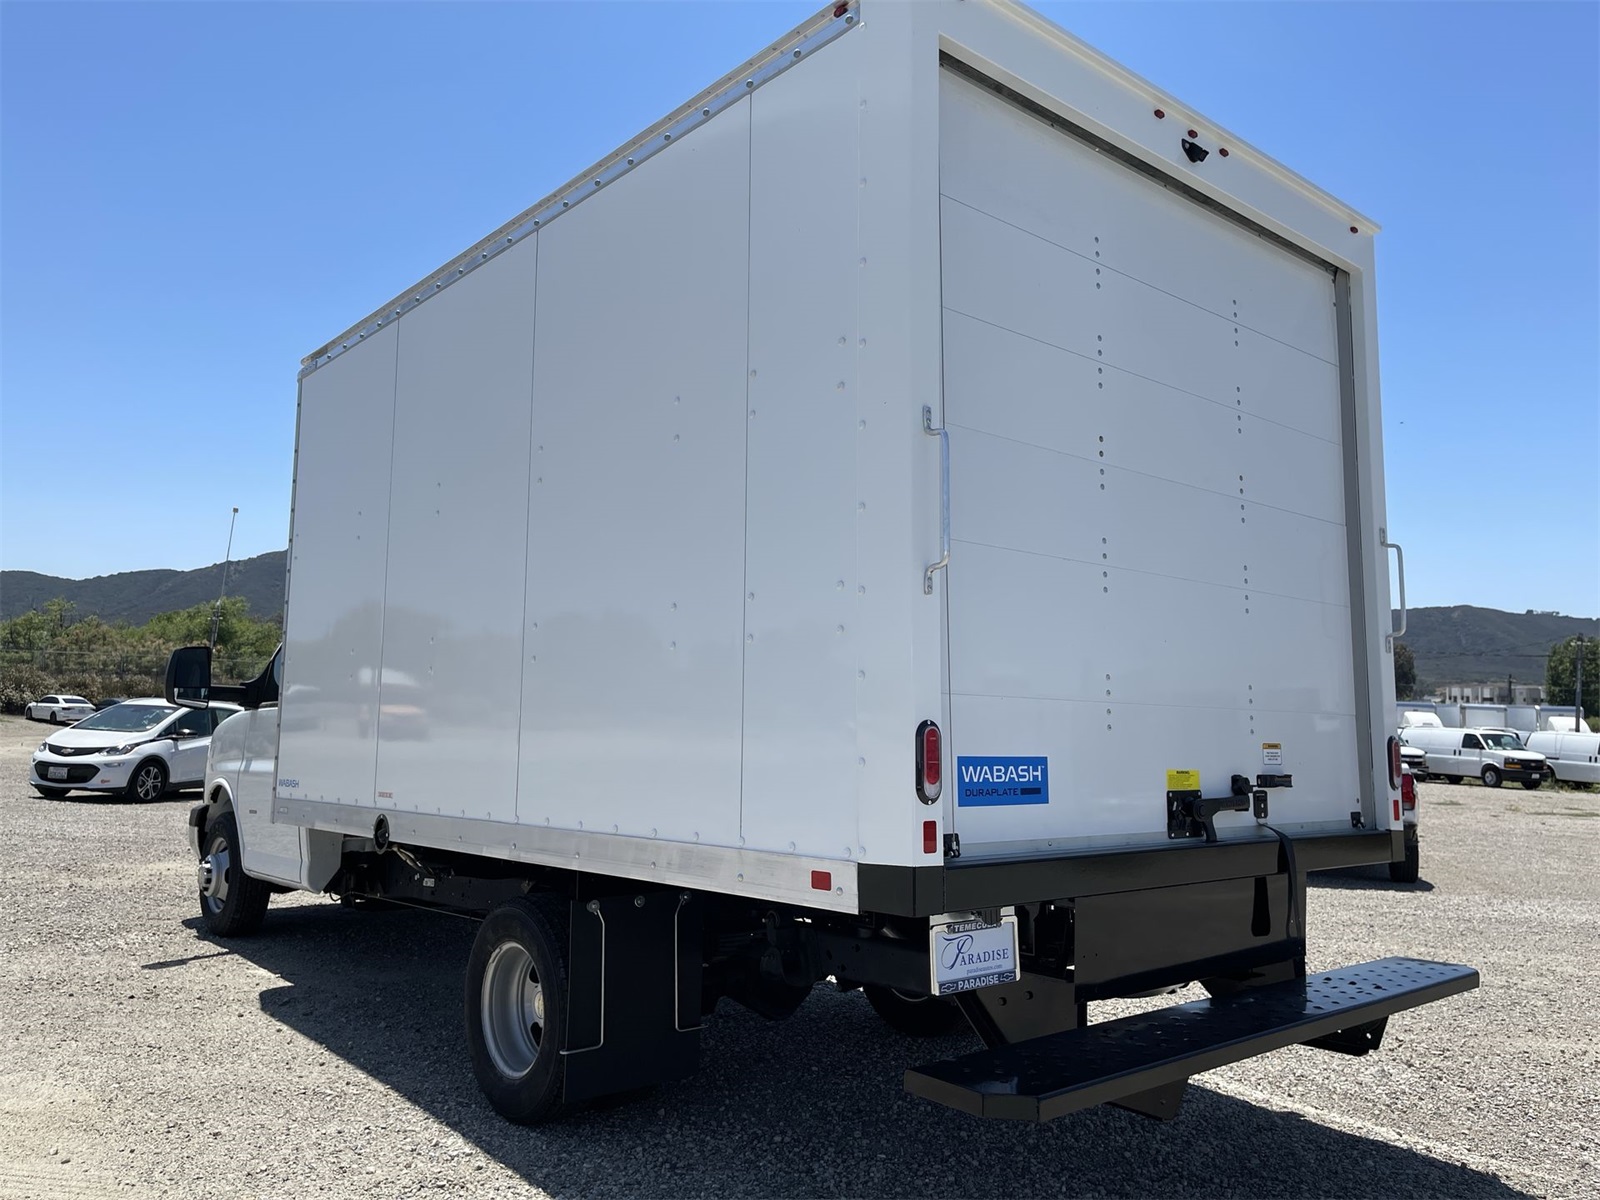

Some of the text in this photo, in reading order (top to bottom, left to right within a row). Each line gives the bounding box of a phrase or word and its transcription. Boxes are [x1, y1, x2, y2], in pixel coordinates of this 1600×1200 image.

[961, 765, 1042, 783] WABASH
[965, 787, 1019, 797] DURAPLATE
[957, 974, 999, 991] PARADISE
